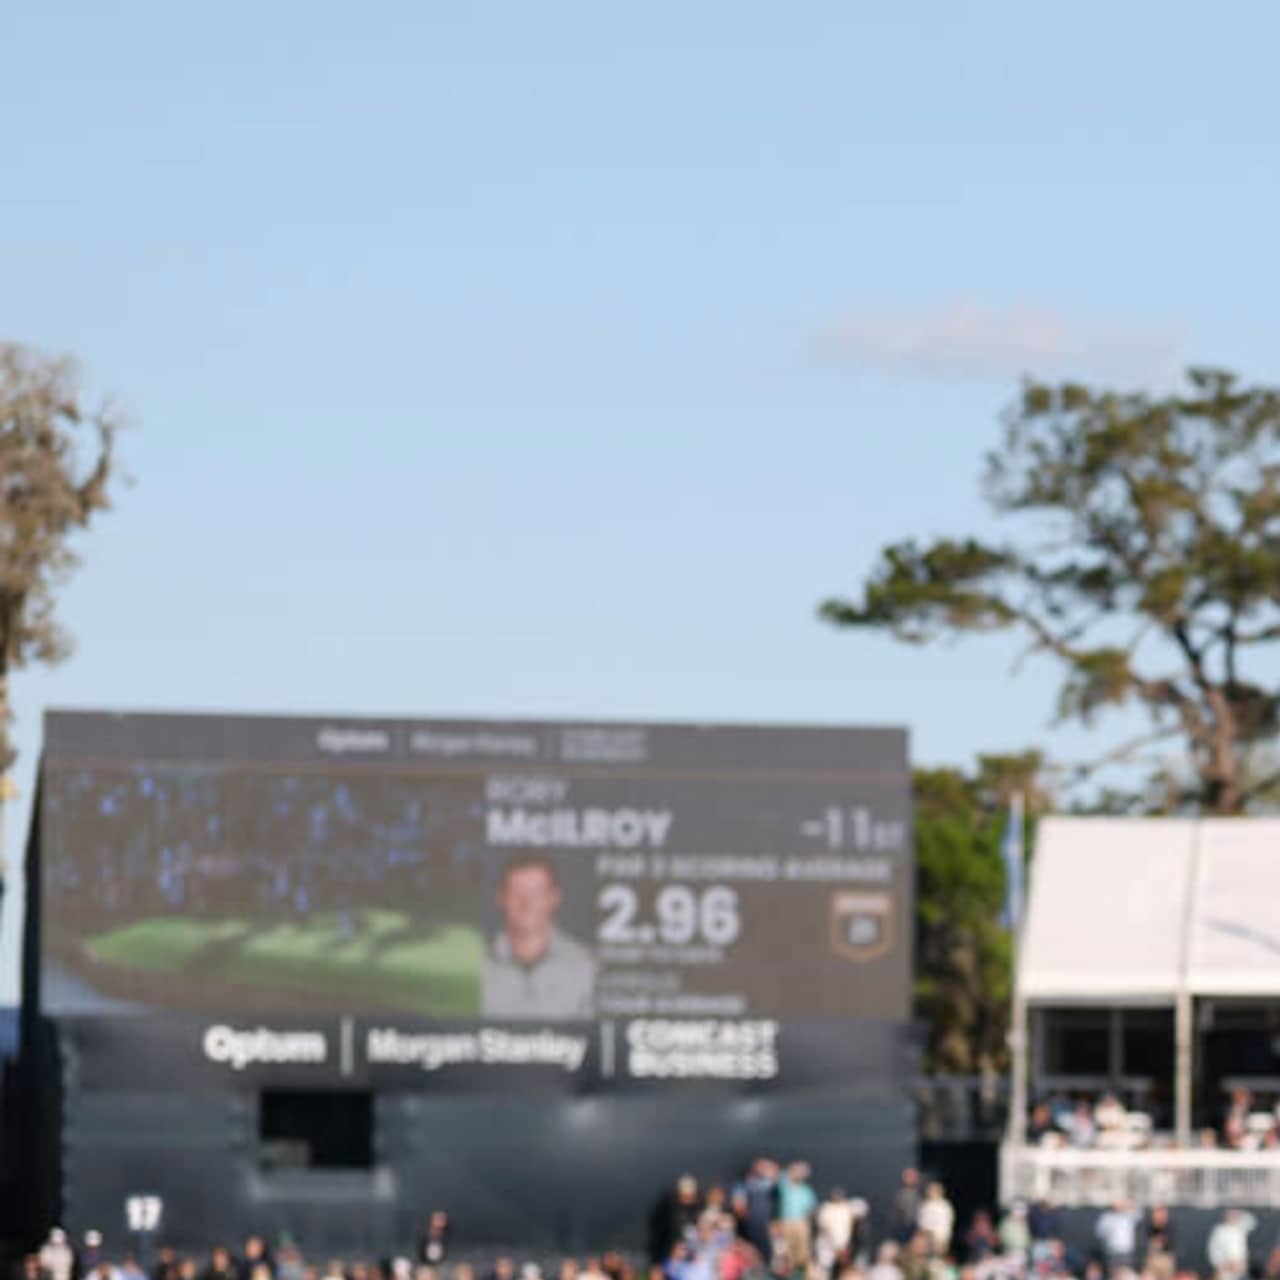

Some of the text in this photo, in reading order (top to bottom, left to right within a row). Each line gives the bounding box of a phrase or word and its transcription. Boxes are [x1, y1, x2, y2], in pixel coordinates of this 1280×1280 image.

[486, 806, 675, 847] McILROY
[597, 884, 741, 945] 2.96
[204, 1025, 326, 1069] Optum
[367, 1028, 588, 1071] Morgan Stanley
[627, 1019, 777, 1048] COMCAST
[628, 1049, 778, 1078] BUSINESS
[127, 1195, 162, 1231] 17
